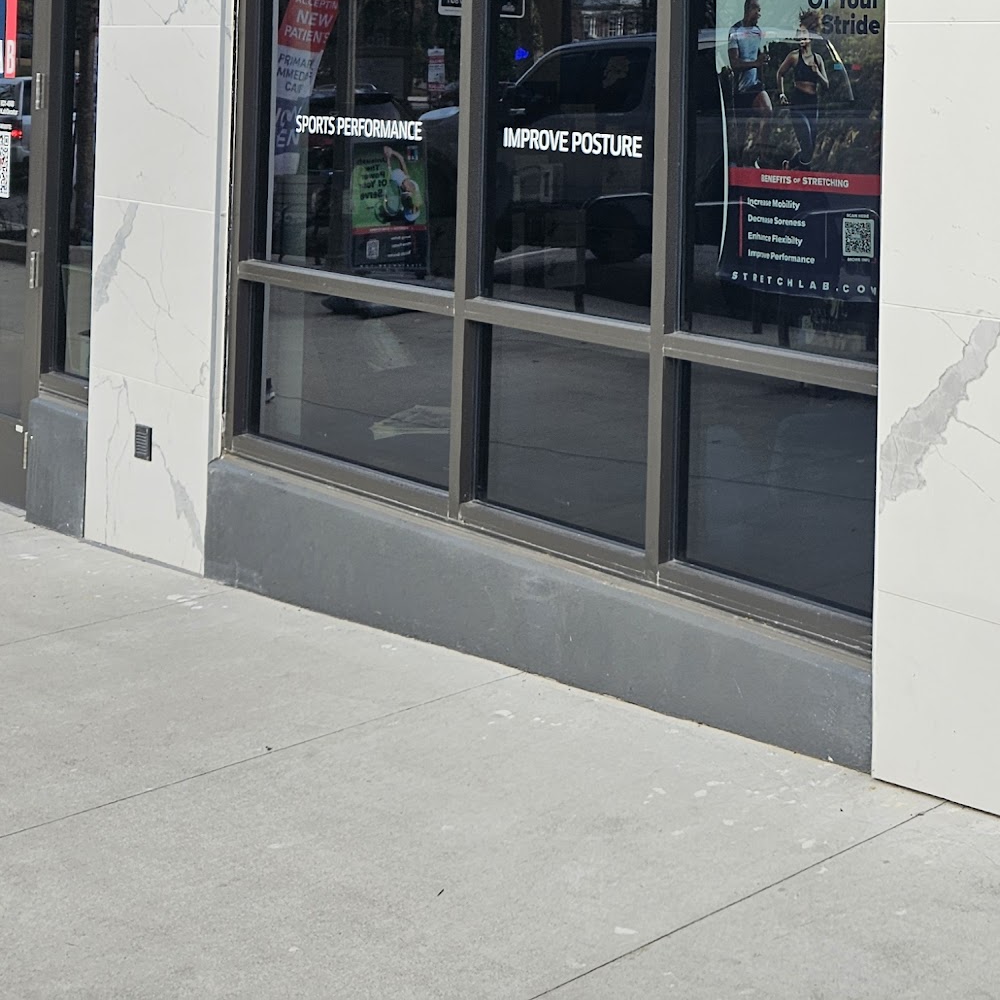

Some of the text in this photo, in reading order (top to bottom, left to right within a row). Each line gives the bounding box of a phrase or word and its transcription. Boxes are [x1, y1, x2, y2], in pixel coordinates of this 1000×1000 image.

[296, 9, 334, 27] NEW
[822, 13, 881, 35] Stride
[295, 114, 336, 135] SPORTS
[336, 116, 423, 142] PERFORMANCE
[503, 127, 643, 159] IMPROVE POSTURE
[761, 174, 792, 185] BENEFITS
[802, 176, 849, 188] STRETCHING
[747, 197, 801, 211] Increase Mobility
[747, 213, 806, 228] Decrease Soreness
[747, 231, 803, 247] Enhance Flexibility
[747, 249, 816, 264] Improve Performance
